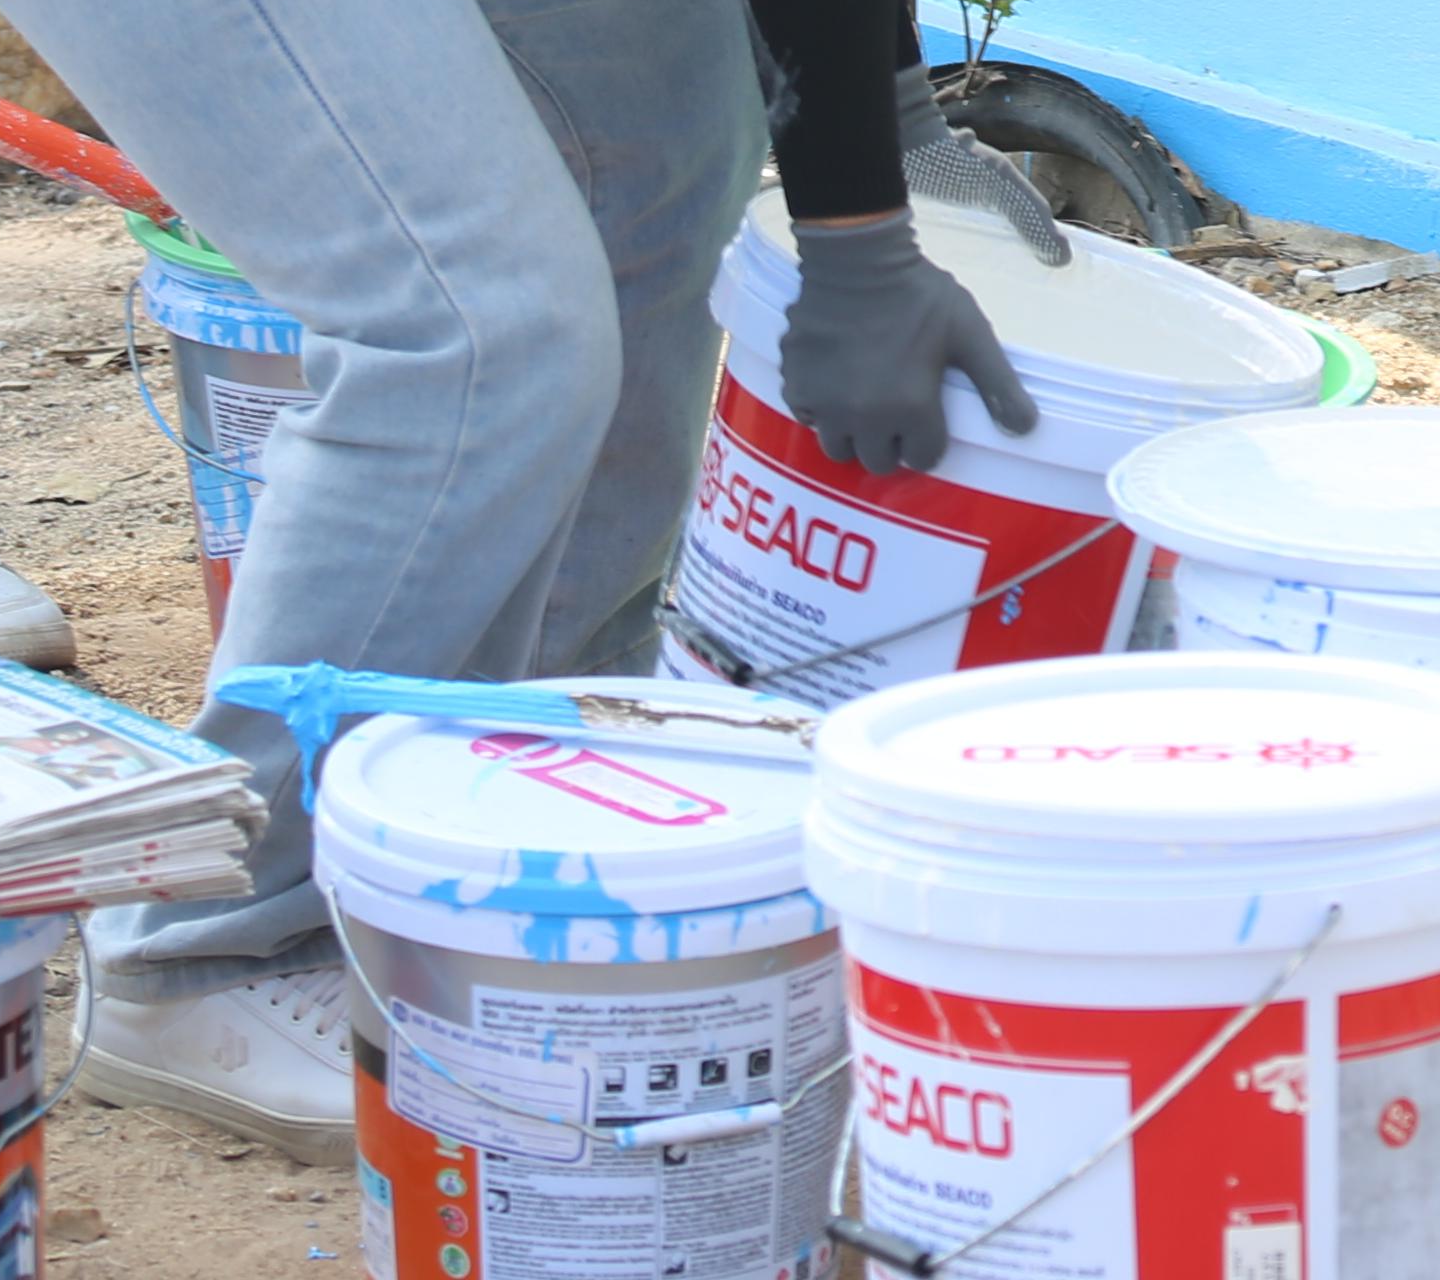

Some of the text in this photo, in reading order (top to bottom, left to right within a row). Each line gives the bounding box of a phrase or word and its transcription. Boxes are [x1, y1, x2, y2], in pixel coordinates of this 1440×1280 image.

[720, 471, 879, 594] SEACO
[961, 743, 1234, 765] SEACO
[860, 1052, 1014, 1160] SEACO
